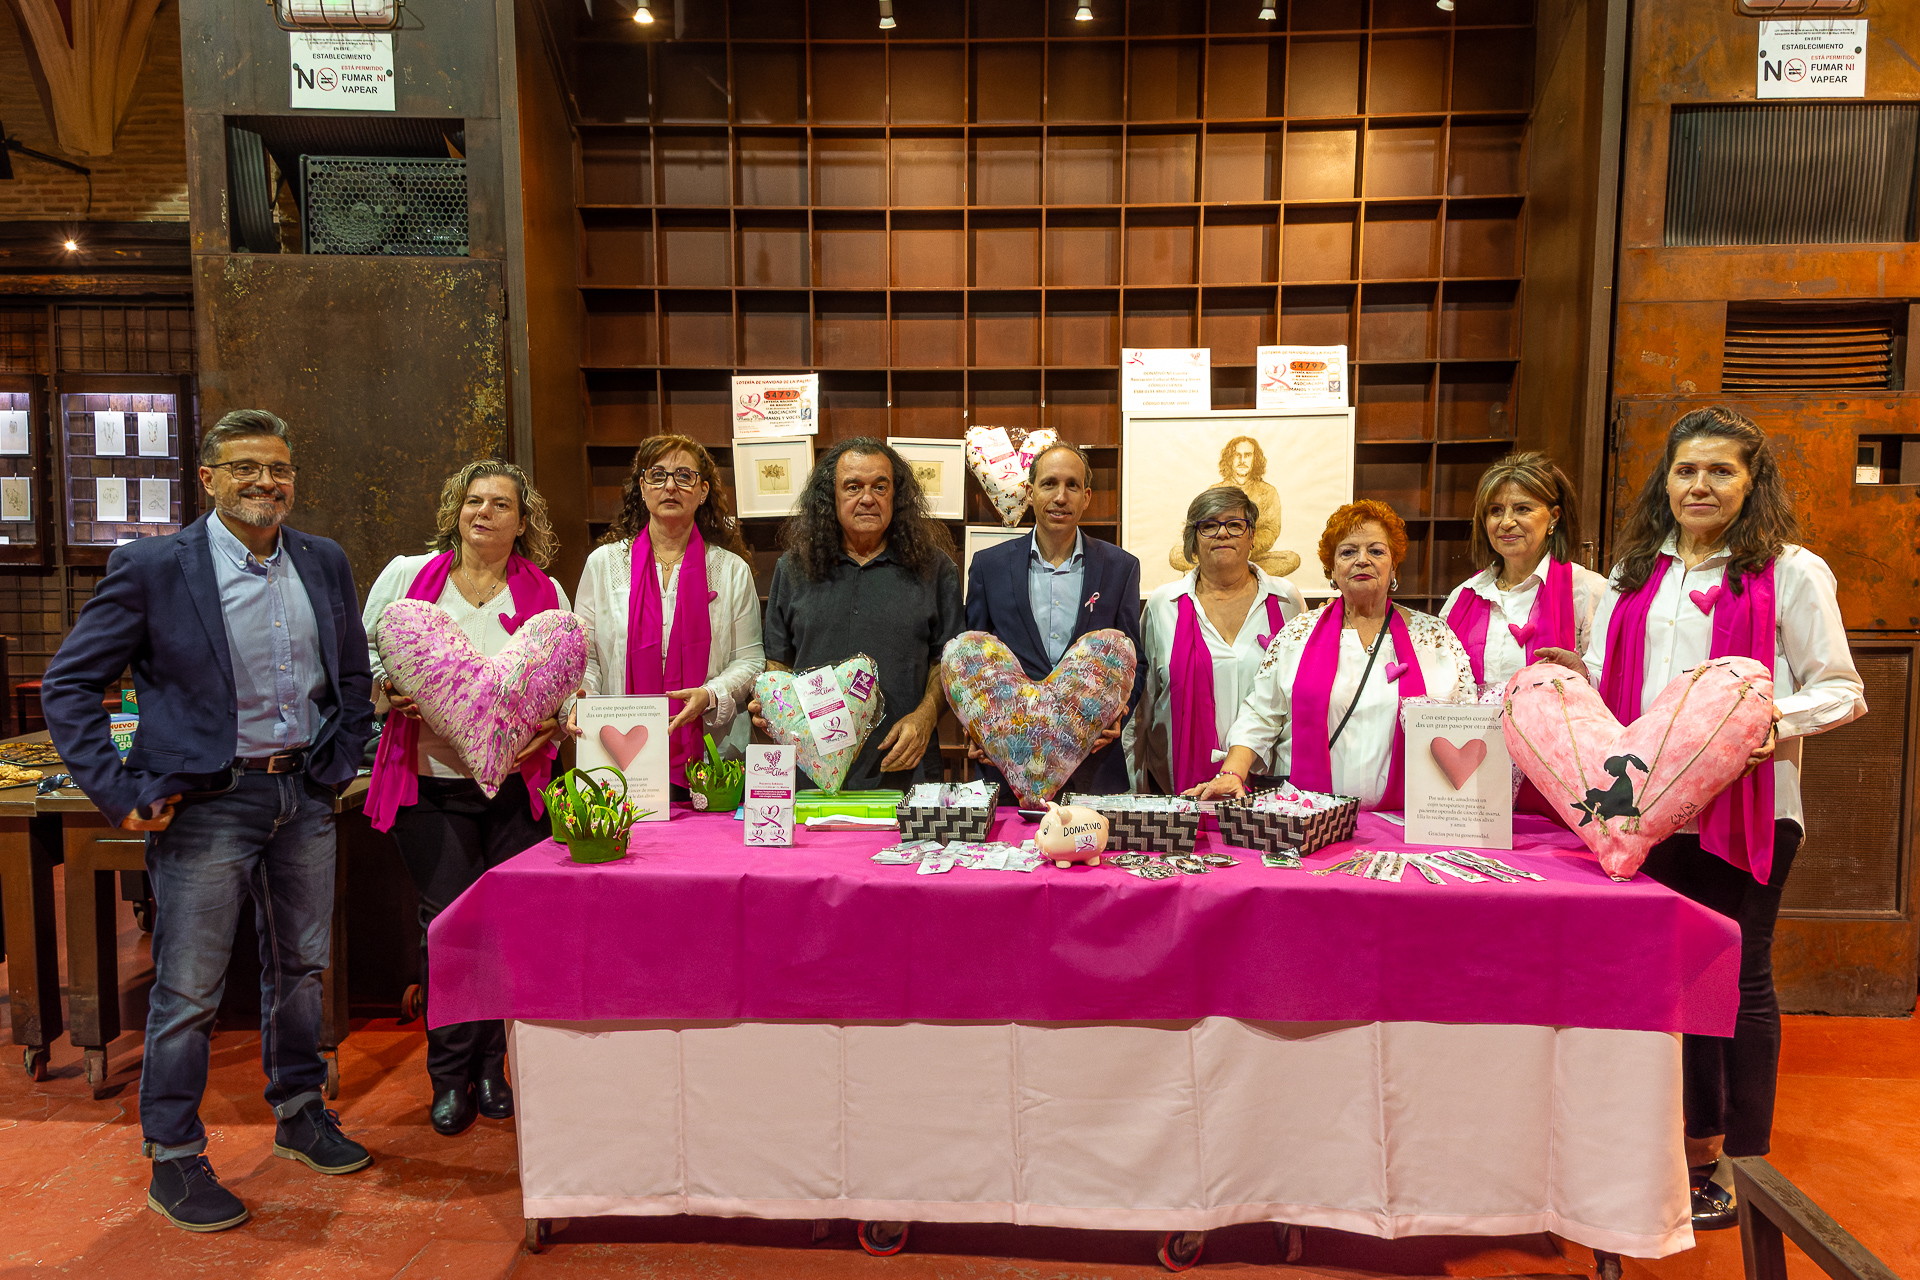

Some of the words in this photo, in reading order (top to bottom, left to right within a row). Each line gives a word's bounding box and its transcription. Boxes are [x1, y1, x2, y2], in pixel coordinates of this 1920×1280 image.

[342, 86, 378, 94] VAPEAR
[766, 391, 798, 399] 54797
[114, 734, 131, 742] sin
[772, 766, 788, 776] Alma
[1064, 822, 1102, 837] DONATIVO
